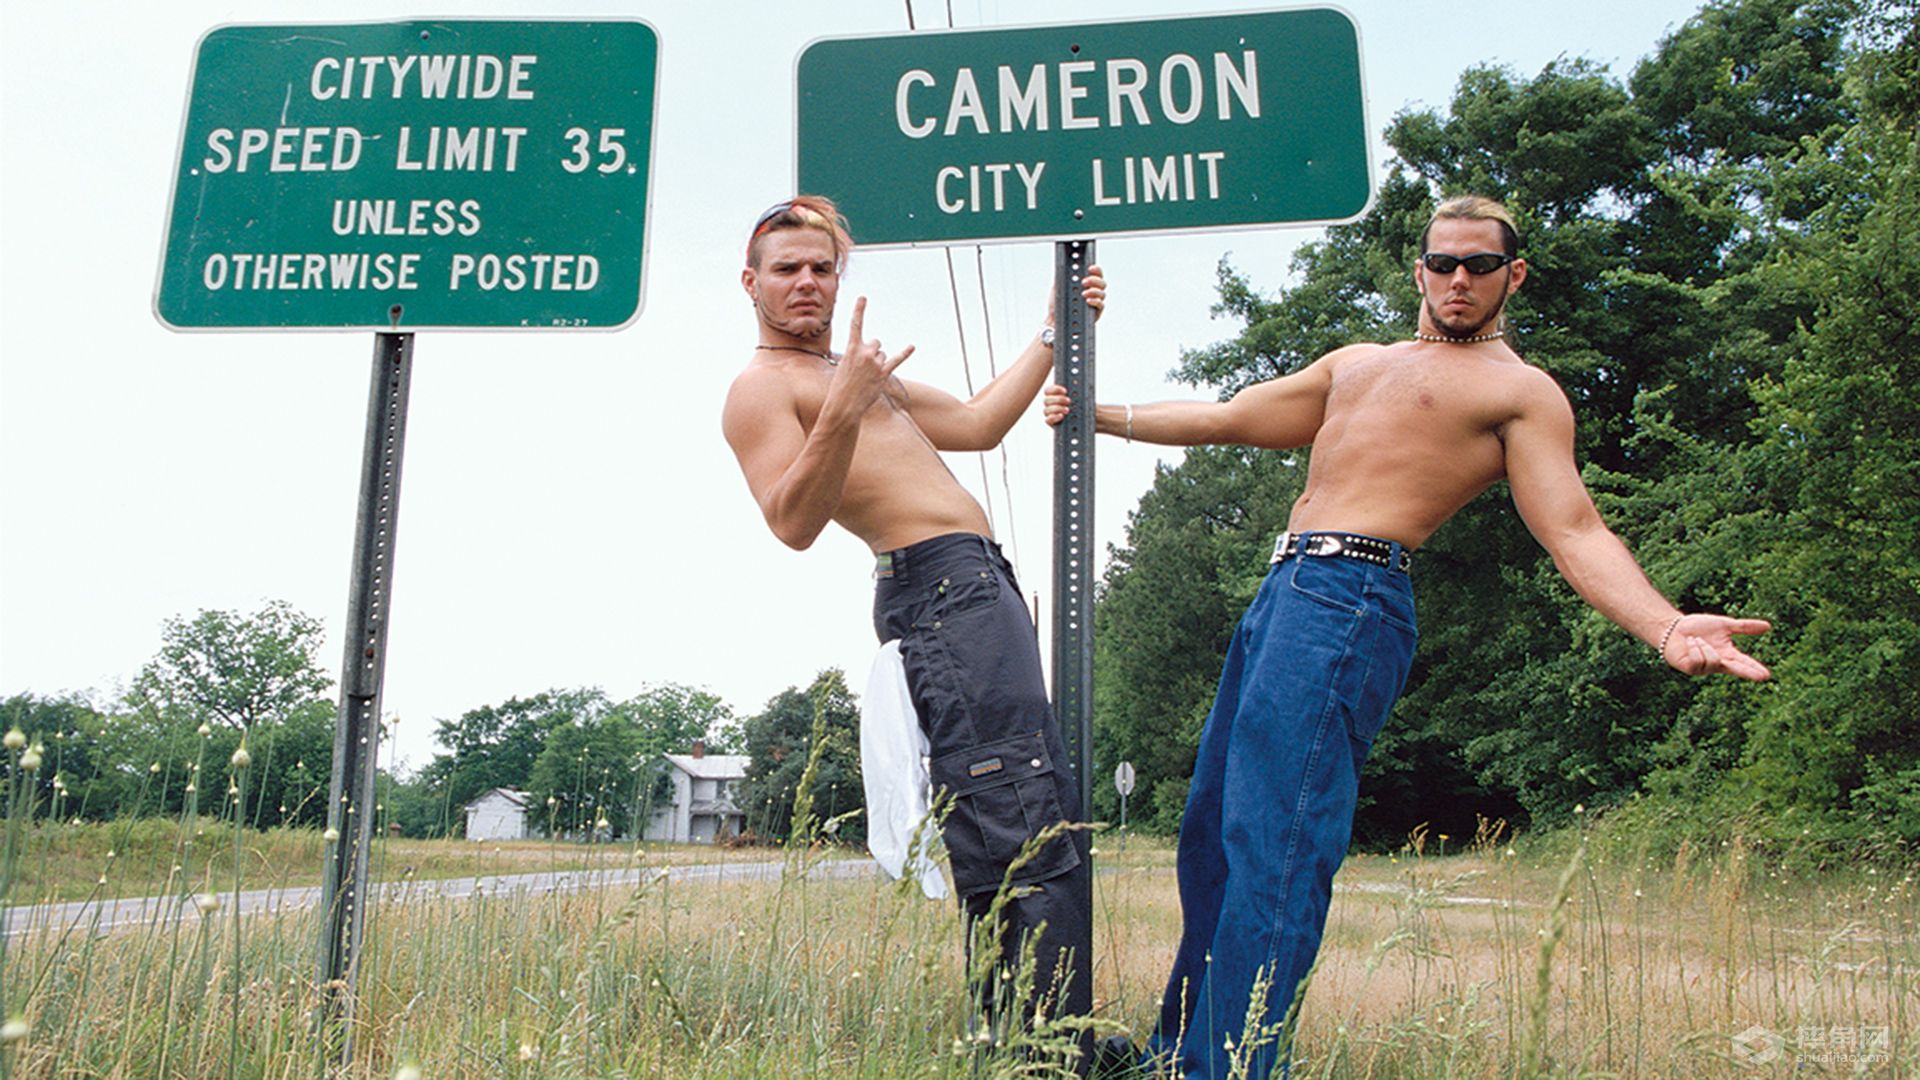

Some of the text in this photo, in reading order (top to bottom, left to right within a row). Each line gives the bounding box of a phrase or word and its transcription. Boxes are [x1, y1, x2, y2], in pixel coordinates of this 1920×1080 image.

[311, 55, 537, 100] CITYWIDE
[896, 50, 1261, 139] CAMERON
[203, 127, 626, 174] SPEED LIMIT 35
[935, 152, 1225, 214] CITY LIMIT
[332, 200, 481, 236] UNLESS
[203, 254, 600, 291] OTHERWISE POSTED
